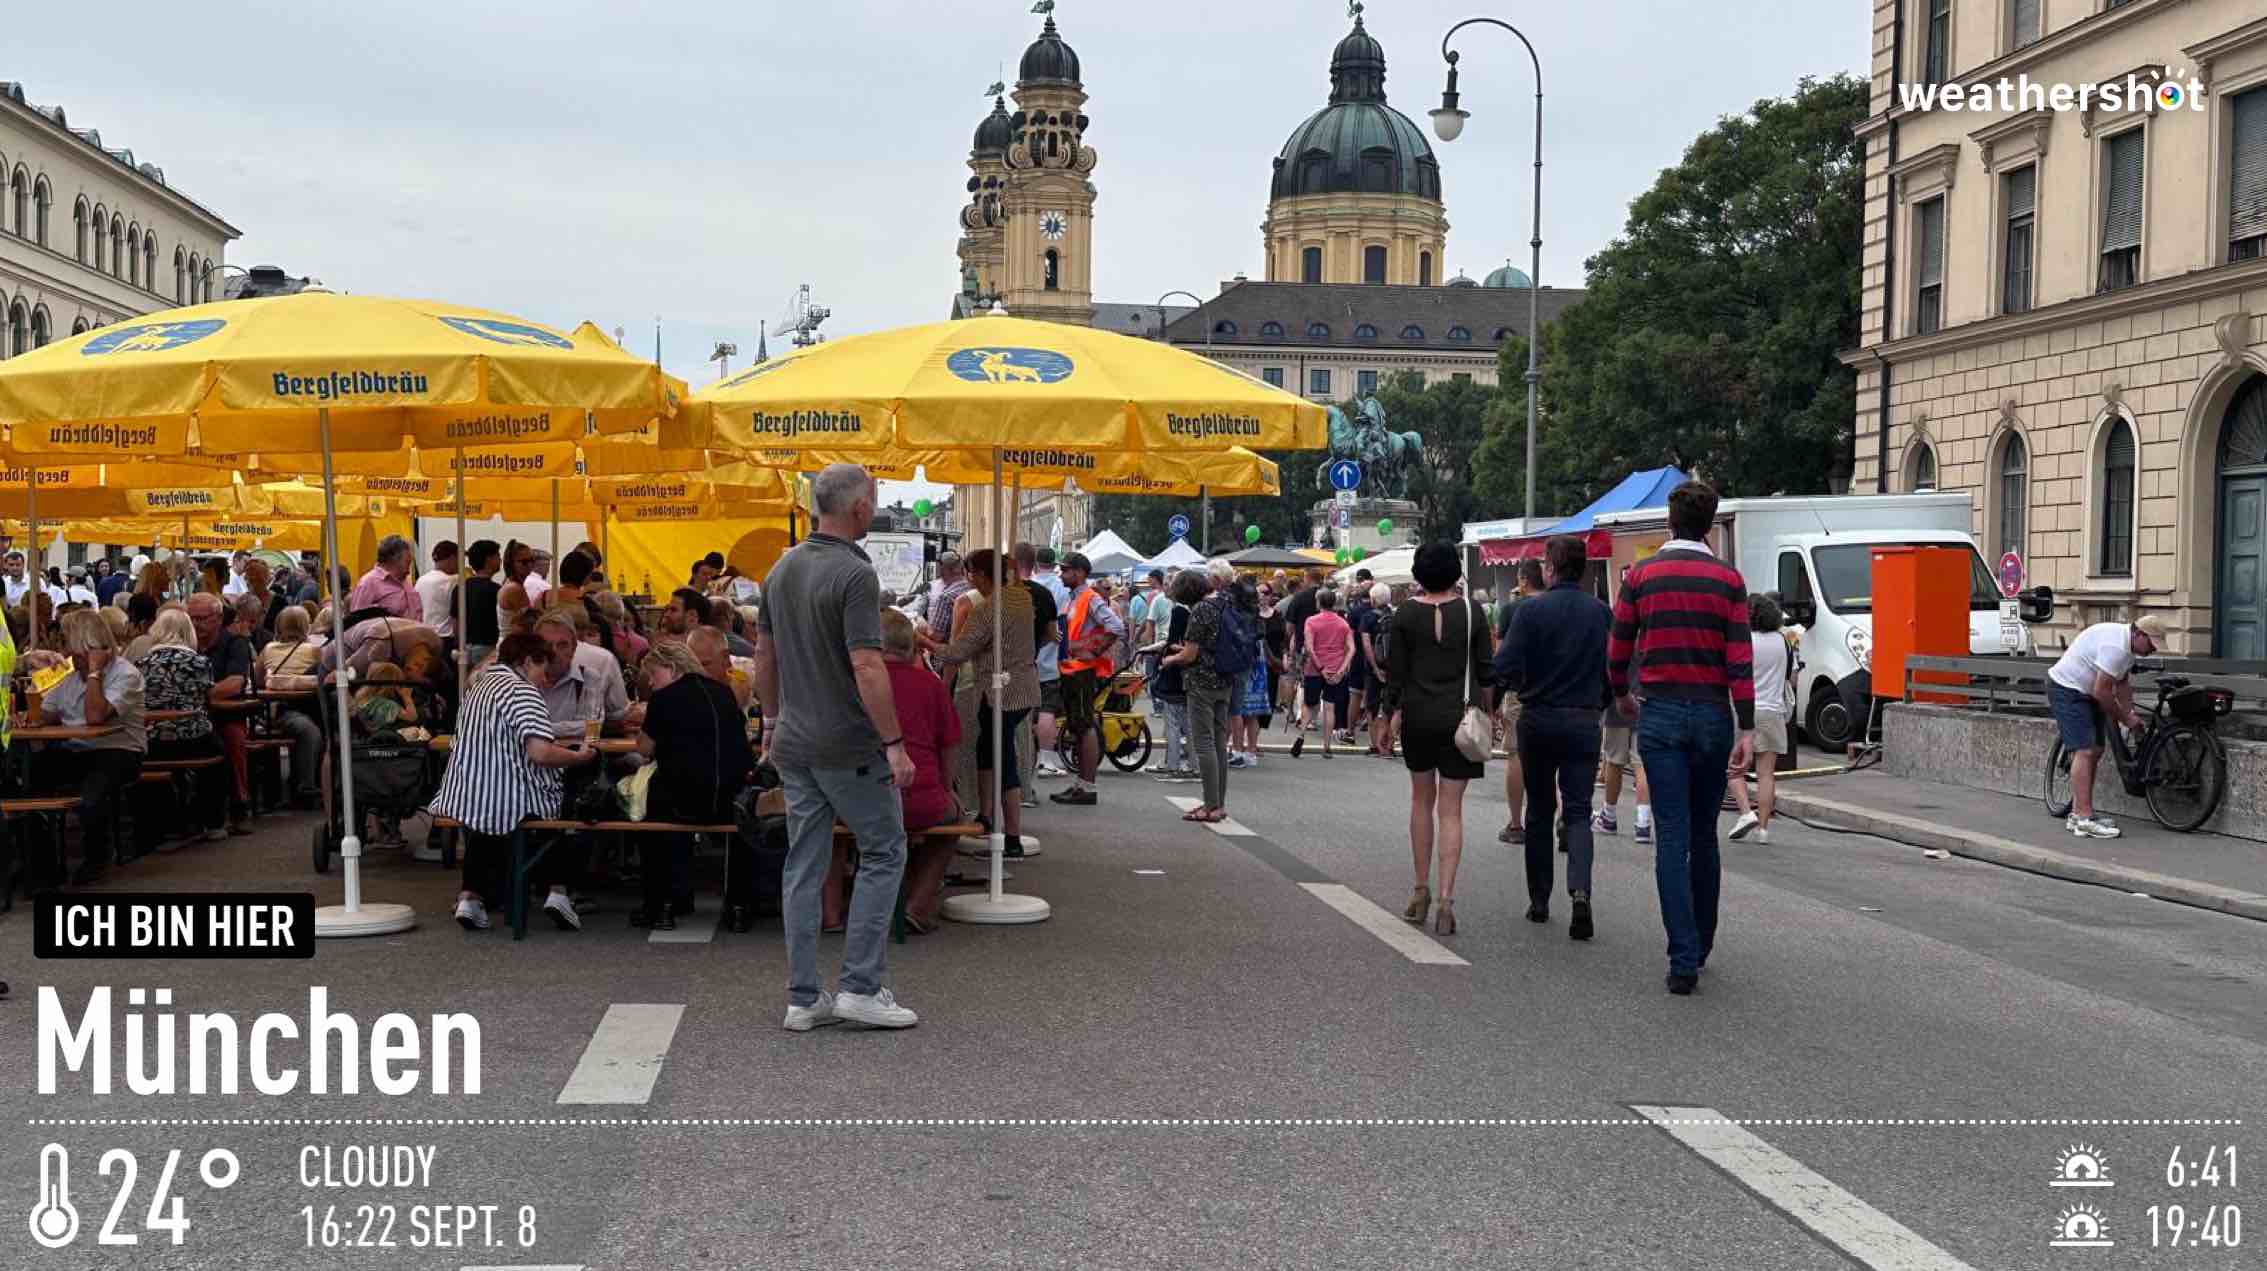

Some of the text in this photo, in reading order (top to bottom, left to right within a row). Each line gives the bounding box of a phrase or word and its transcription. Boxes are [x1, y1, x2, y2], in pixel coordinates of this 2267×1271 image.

[272, 371, 428, 400] Bergfeldbräu
[753, 410, 861, 437] Bergfeldbräu
[1167, 413, 1260, 439] Bergfeldbräu
[1002, 448, 1095, 469] ergfeldbräu
